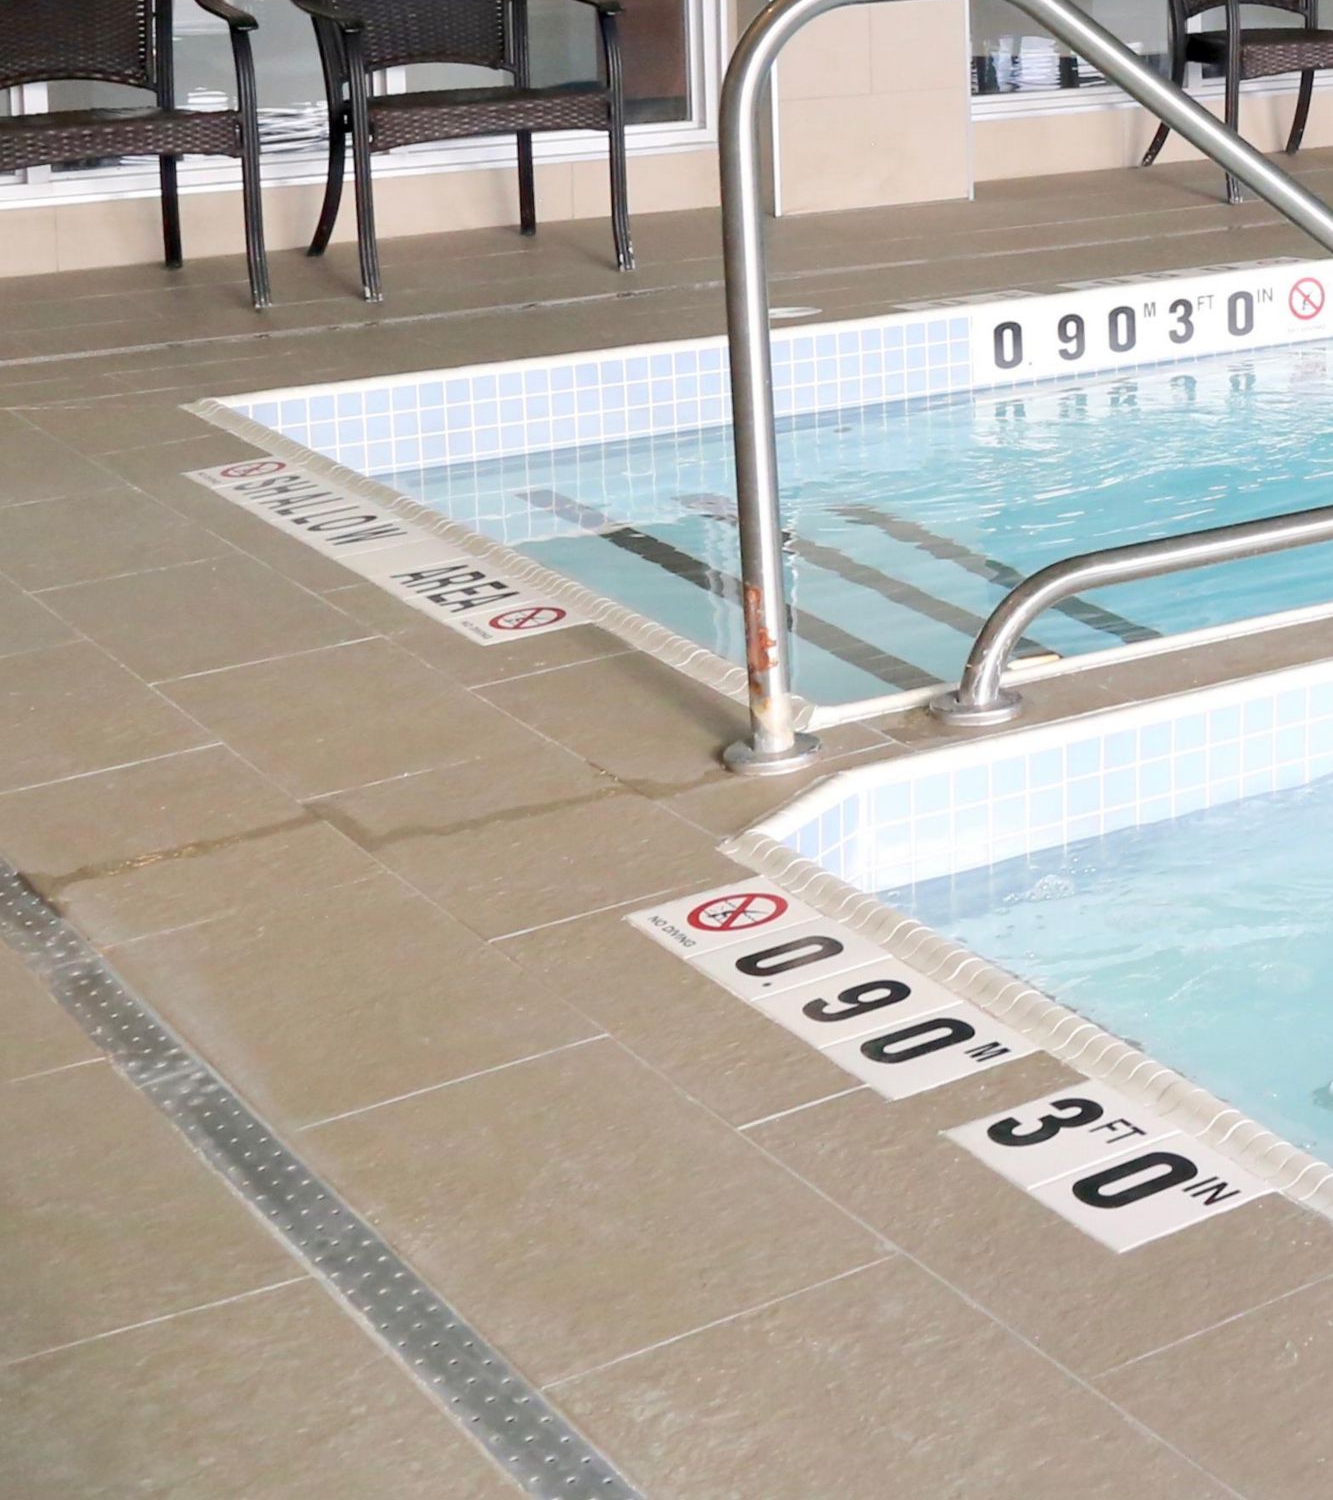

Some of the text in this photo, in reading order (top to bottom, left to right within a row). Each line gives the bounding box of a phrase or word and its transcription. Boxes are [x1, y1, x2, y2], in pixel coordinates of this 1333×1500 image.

[233, 474, 521, 614] SHALLOW AREA
[647, 916, 697, 948] NO DIVING
